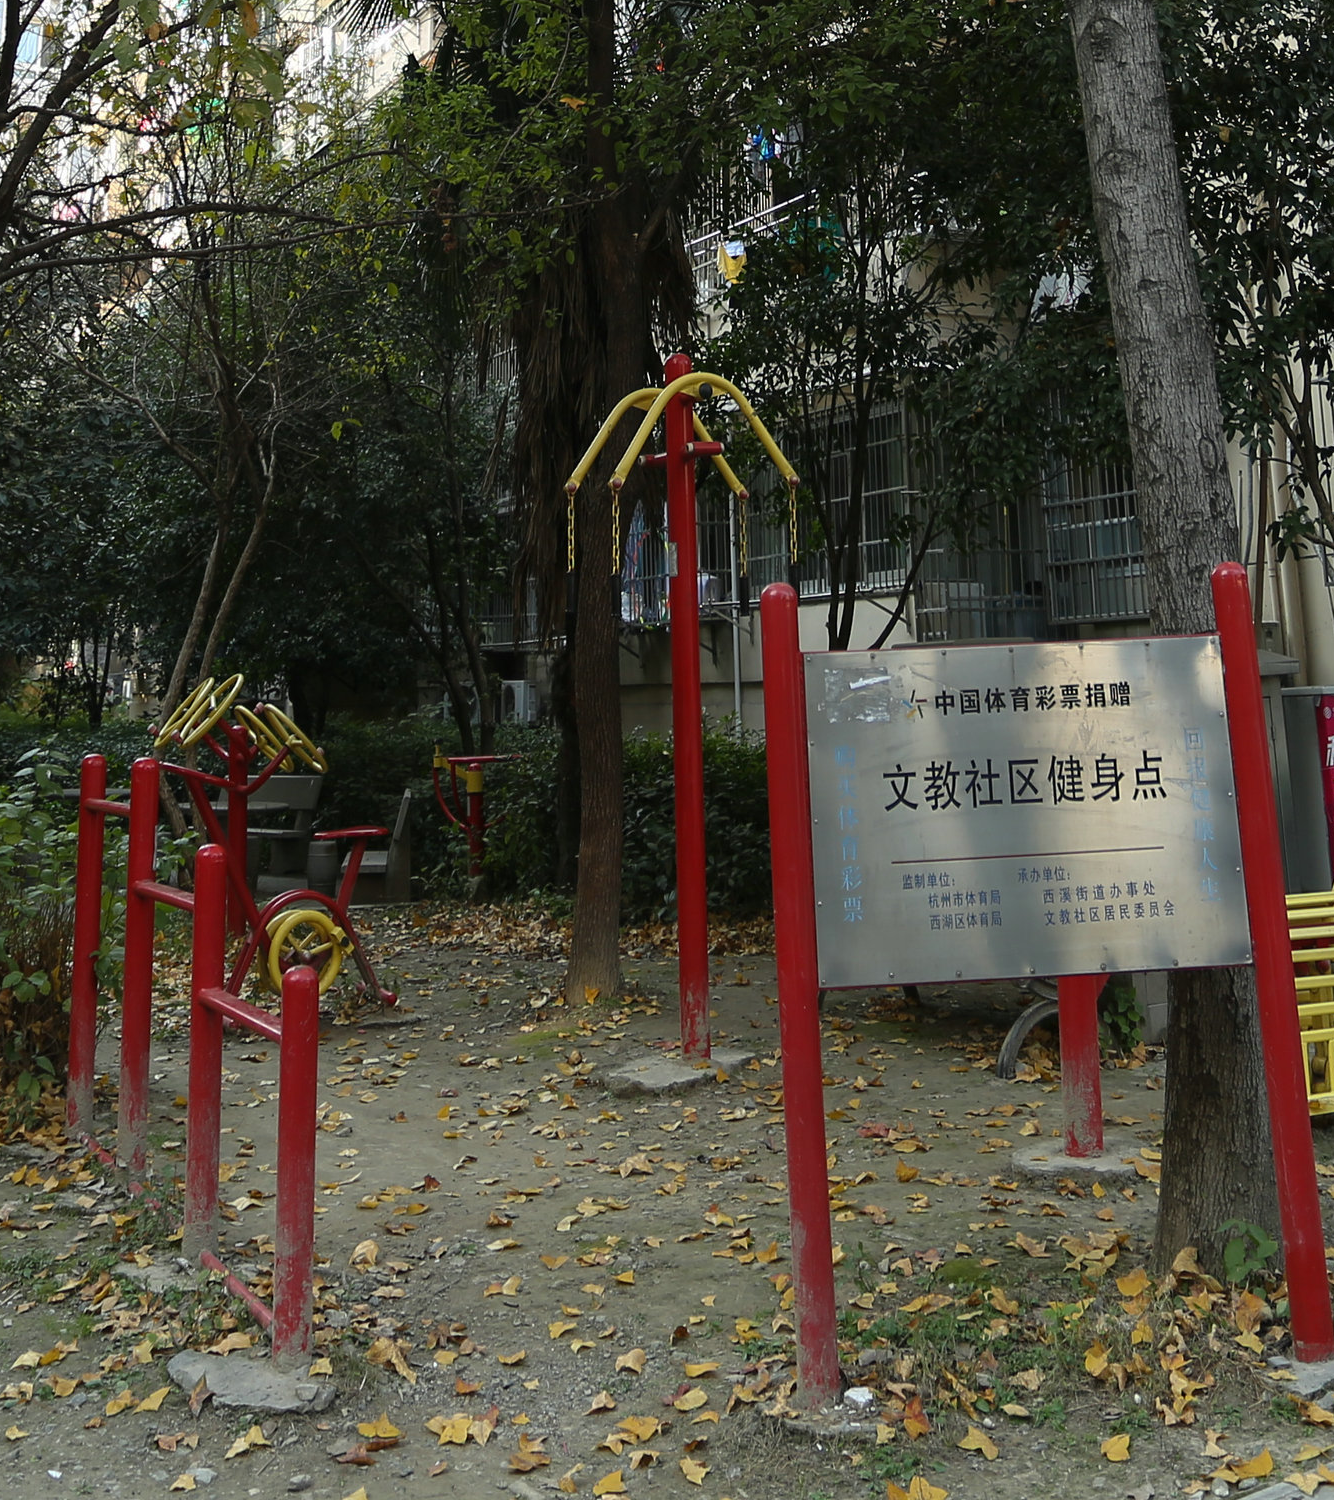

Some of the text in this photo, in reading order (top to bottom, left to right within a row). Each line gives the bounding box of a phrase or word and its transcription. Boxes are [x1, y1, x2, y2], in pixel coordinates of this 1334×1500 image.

[934, 681, 1131, 716] 中国体育彩票捐赠
[883, 749, 1168, 813] 文教社区健身点
[928, 889, 1001, 909] 杭州市体育局
[1043, 880, 1155, 904] 西溪街道办事处
[930, 911, 1003, 930] 西湖区体育局
[1044, 900, 1175, 927] 文教社区居民委员会
